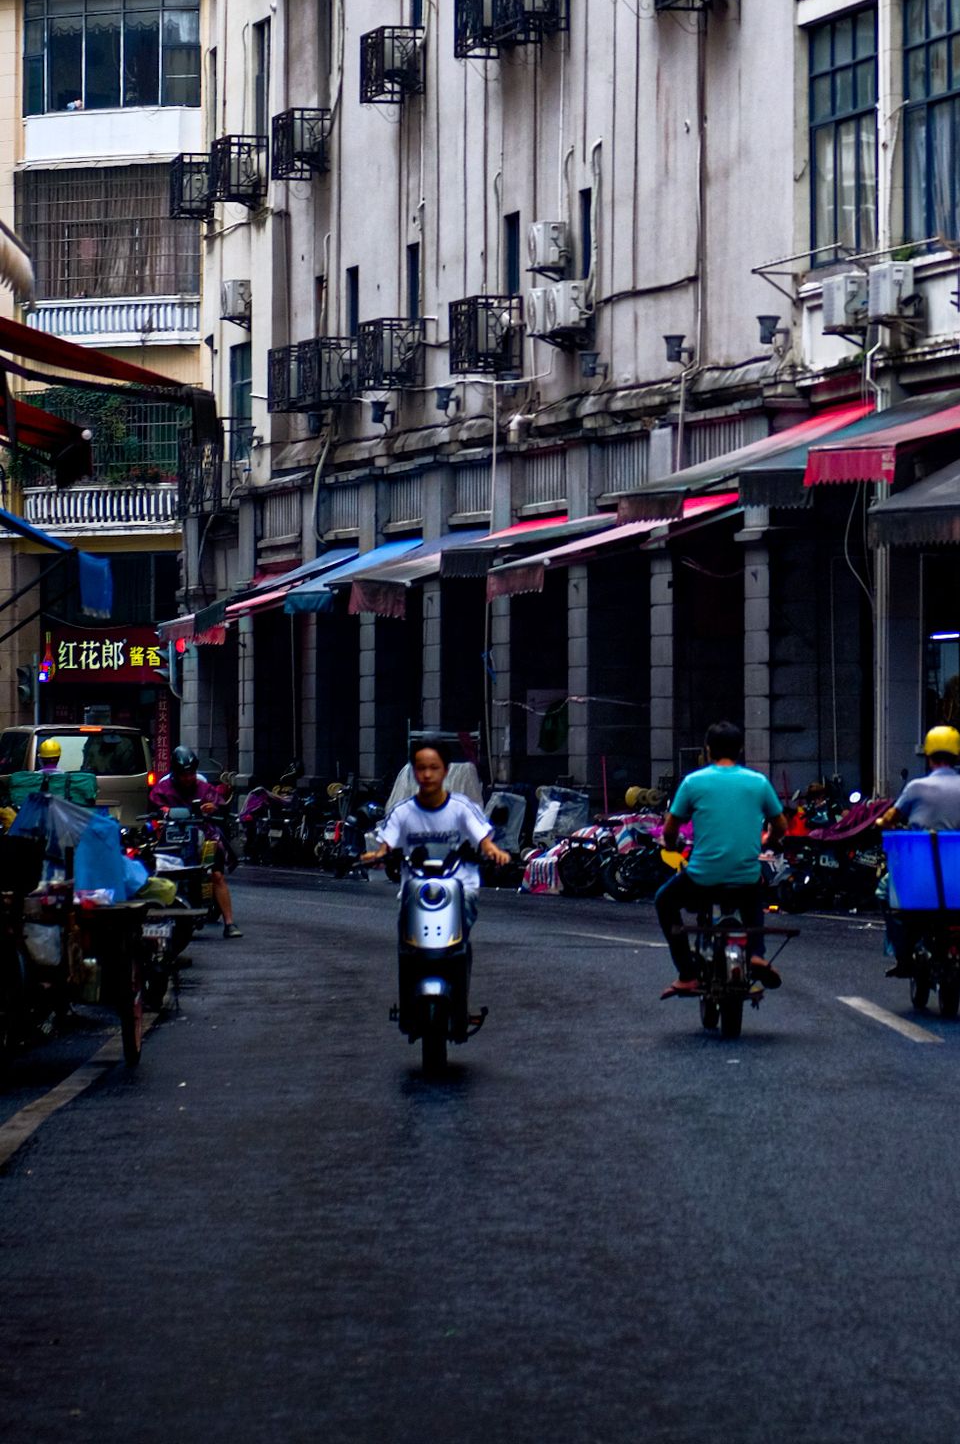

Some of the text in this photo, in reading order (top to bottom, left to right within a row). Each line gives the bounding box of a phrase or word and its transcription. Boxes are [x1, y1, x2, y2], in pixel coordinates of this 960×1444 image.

[58, 639, 125, 670] 红花郎
[129, 646, 161, 666] 酱香
